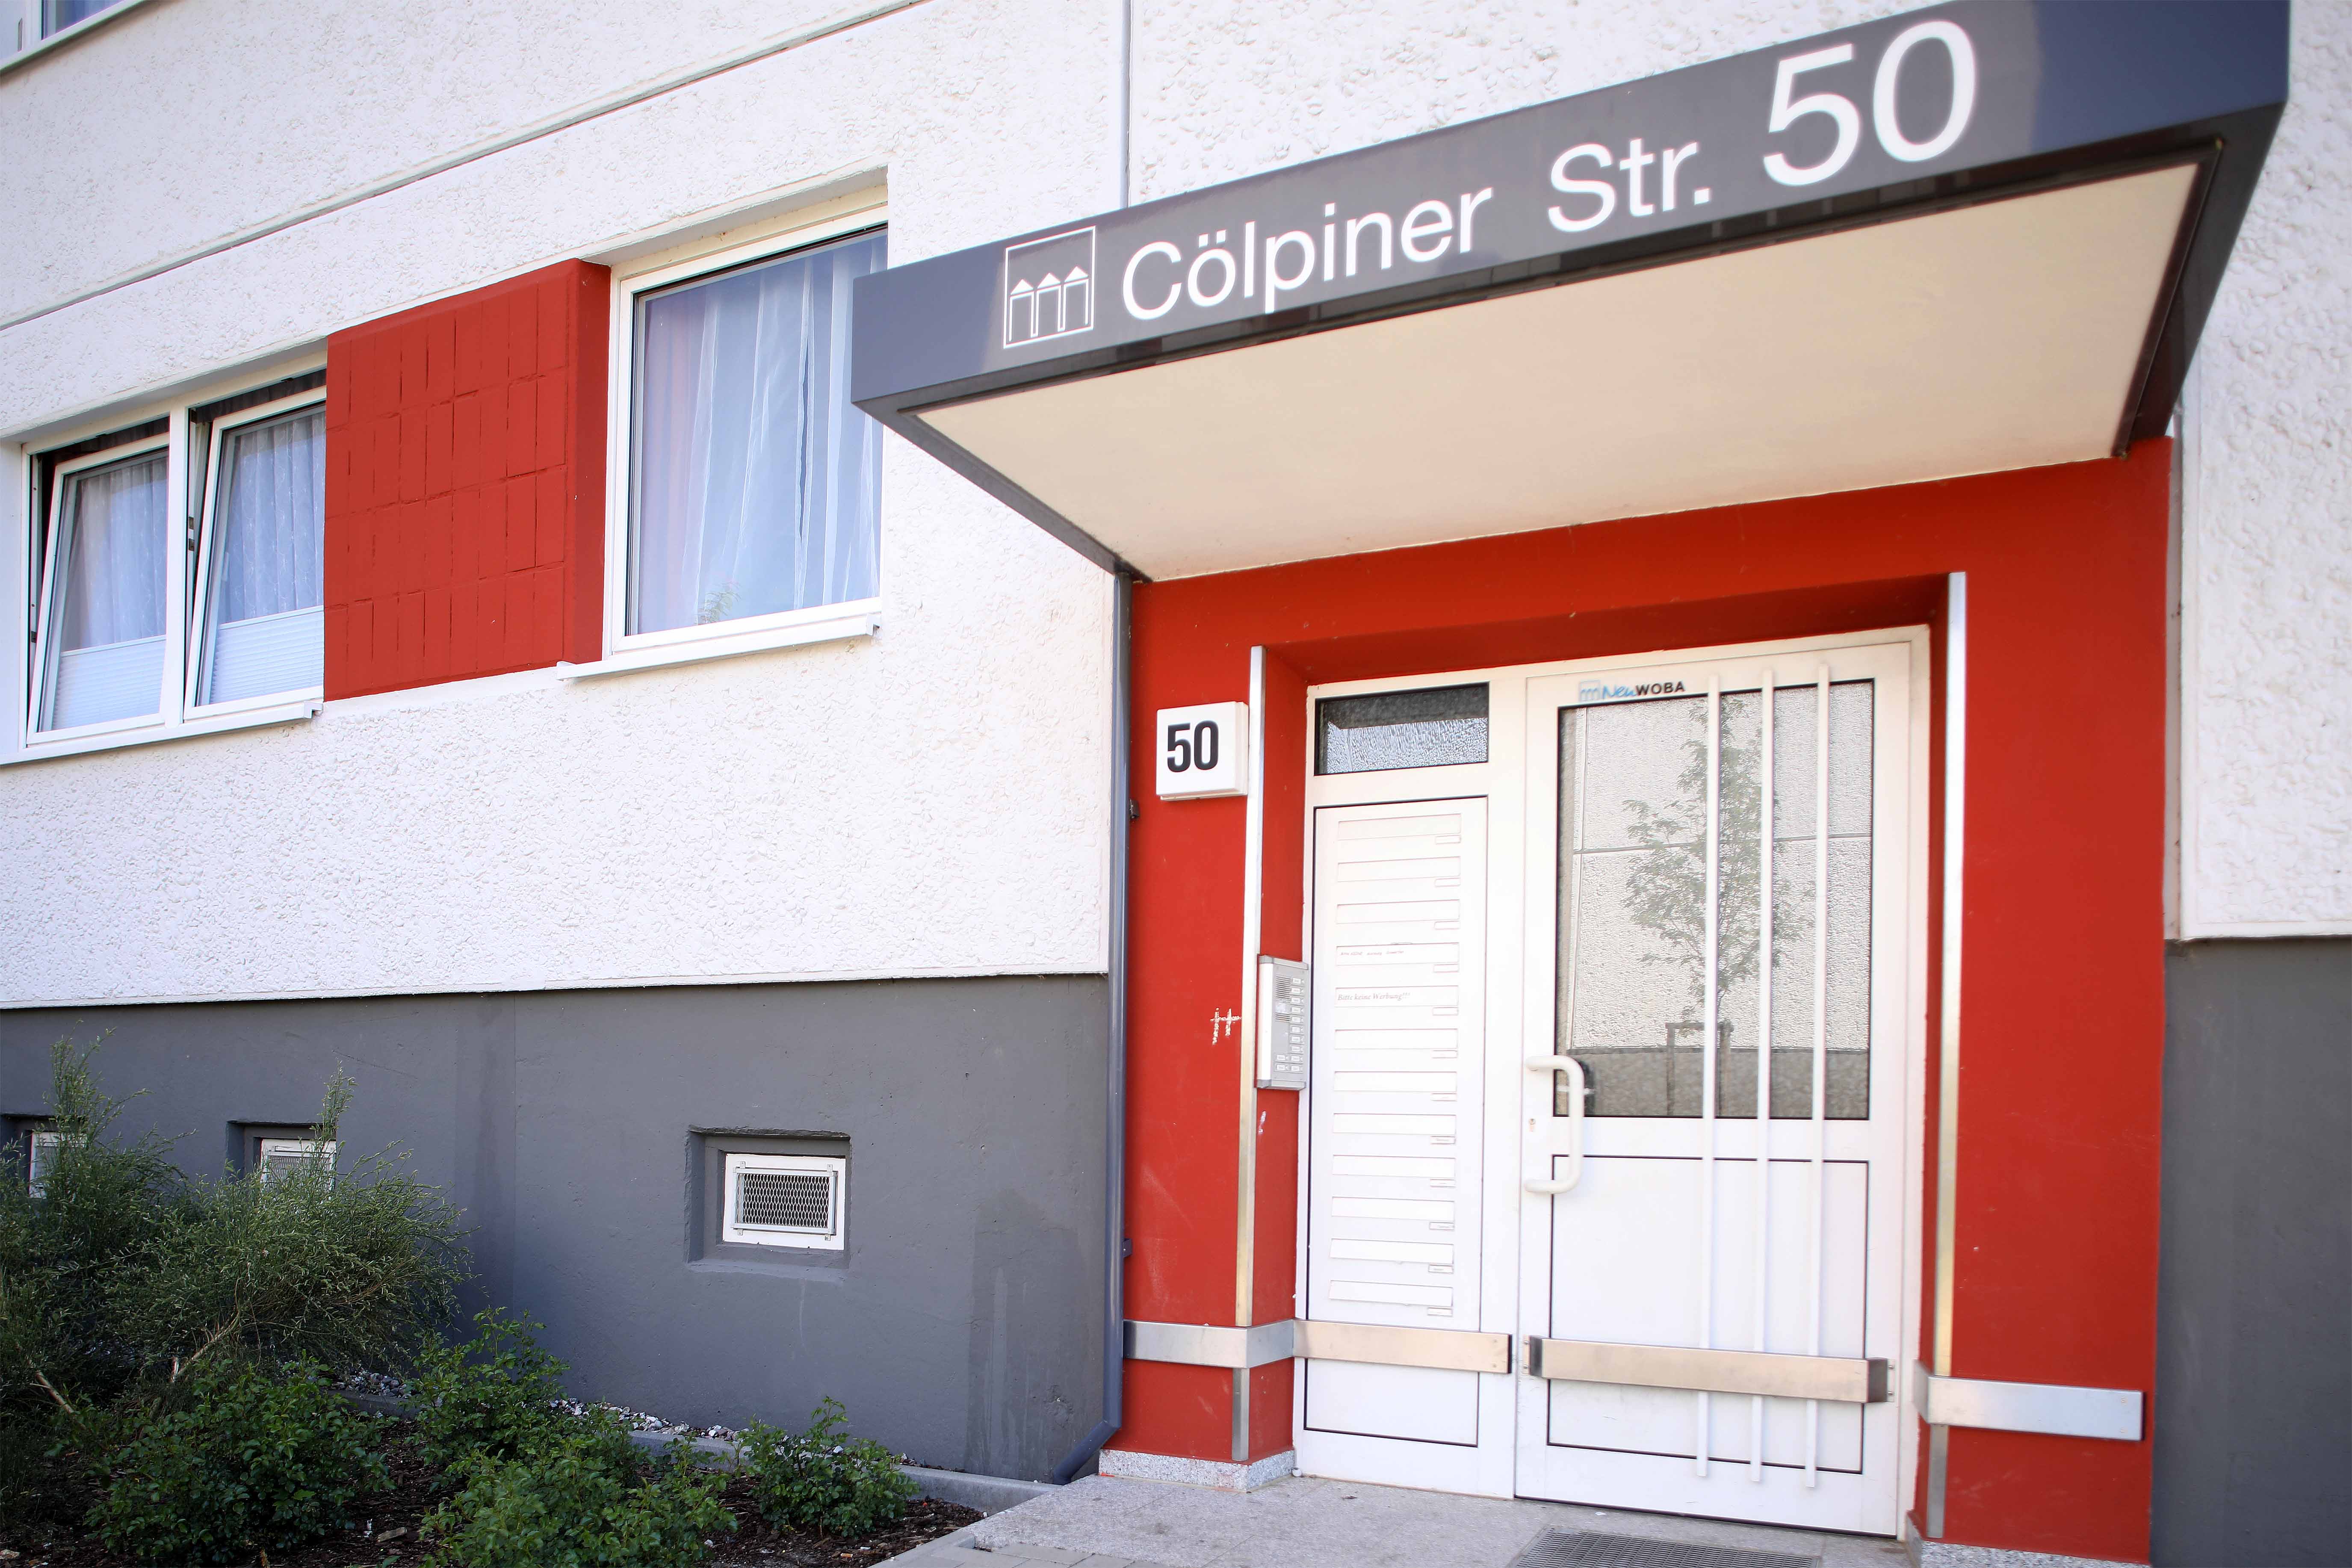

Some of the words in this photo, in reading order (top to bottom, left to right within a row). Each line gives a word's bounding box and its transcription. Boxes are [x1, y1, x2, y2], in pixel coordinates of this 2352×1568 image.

[1121, 186, 1494, 314] Cölpiner
[1548, 138, 1712, 233] Str.
[1763, 20, 1977, 187] 50
[1167, 720, 1219, 773] 50
